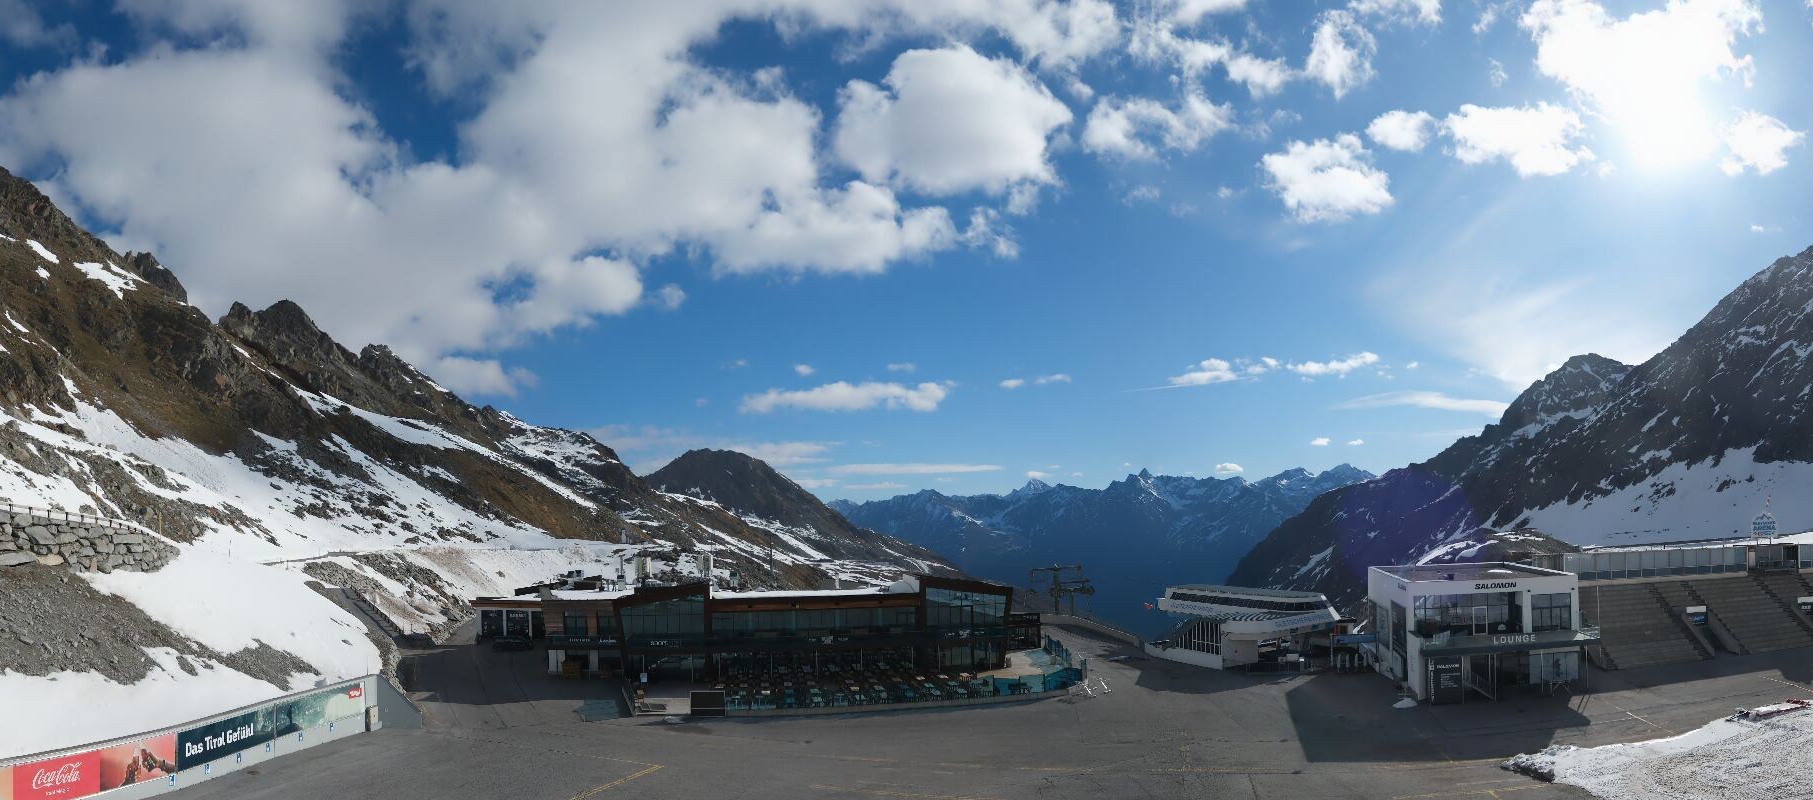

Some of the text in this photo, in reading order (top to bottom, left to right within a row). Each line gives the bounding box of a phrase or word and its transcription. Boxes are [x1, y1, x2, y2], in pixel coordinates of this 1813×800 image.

[1474, 581, 1517, 590] SALOMON
[1493, 634, 1536, 645] LOUNGE
[185, 723, 254, 757] Das Tirol Gefühl
[32, 762, 82, 790] Coca-Cola
